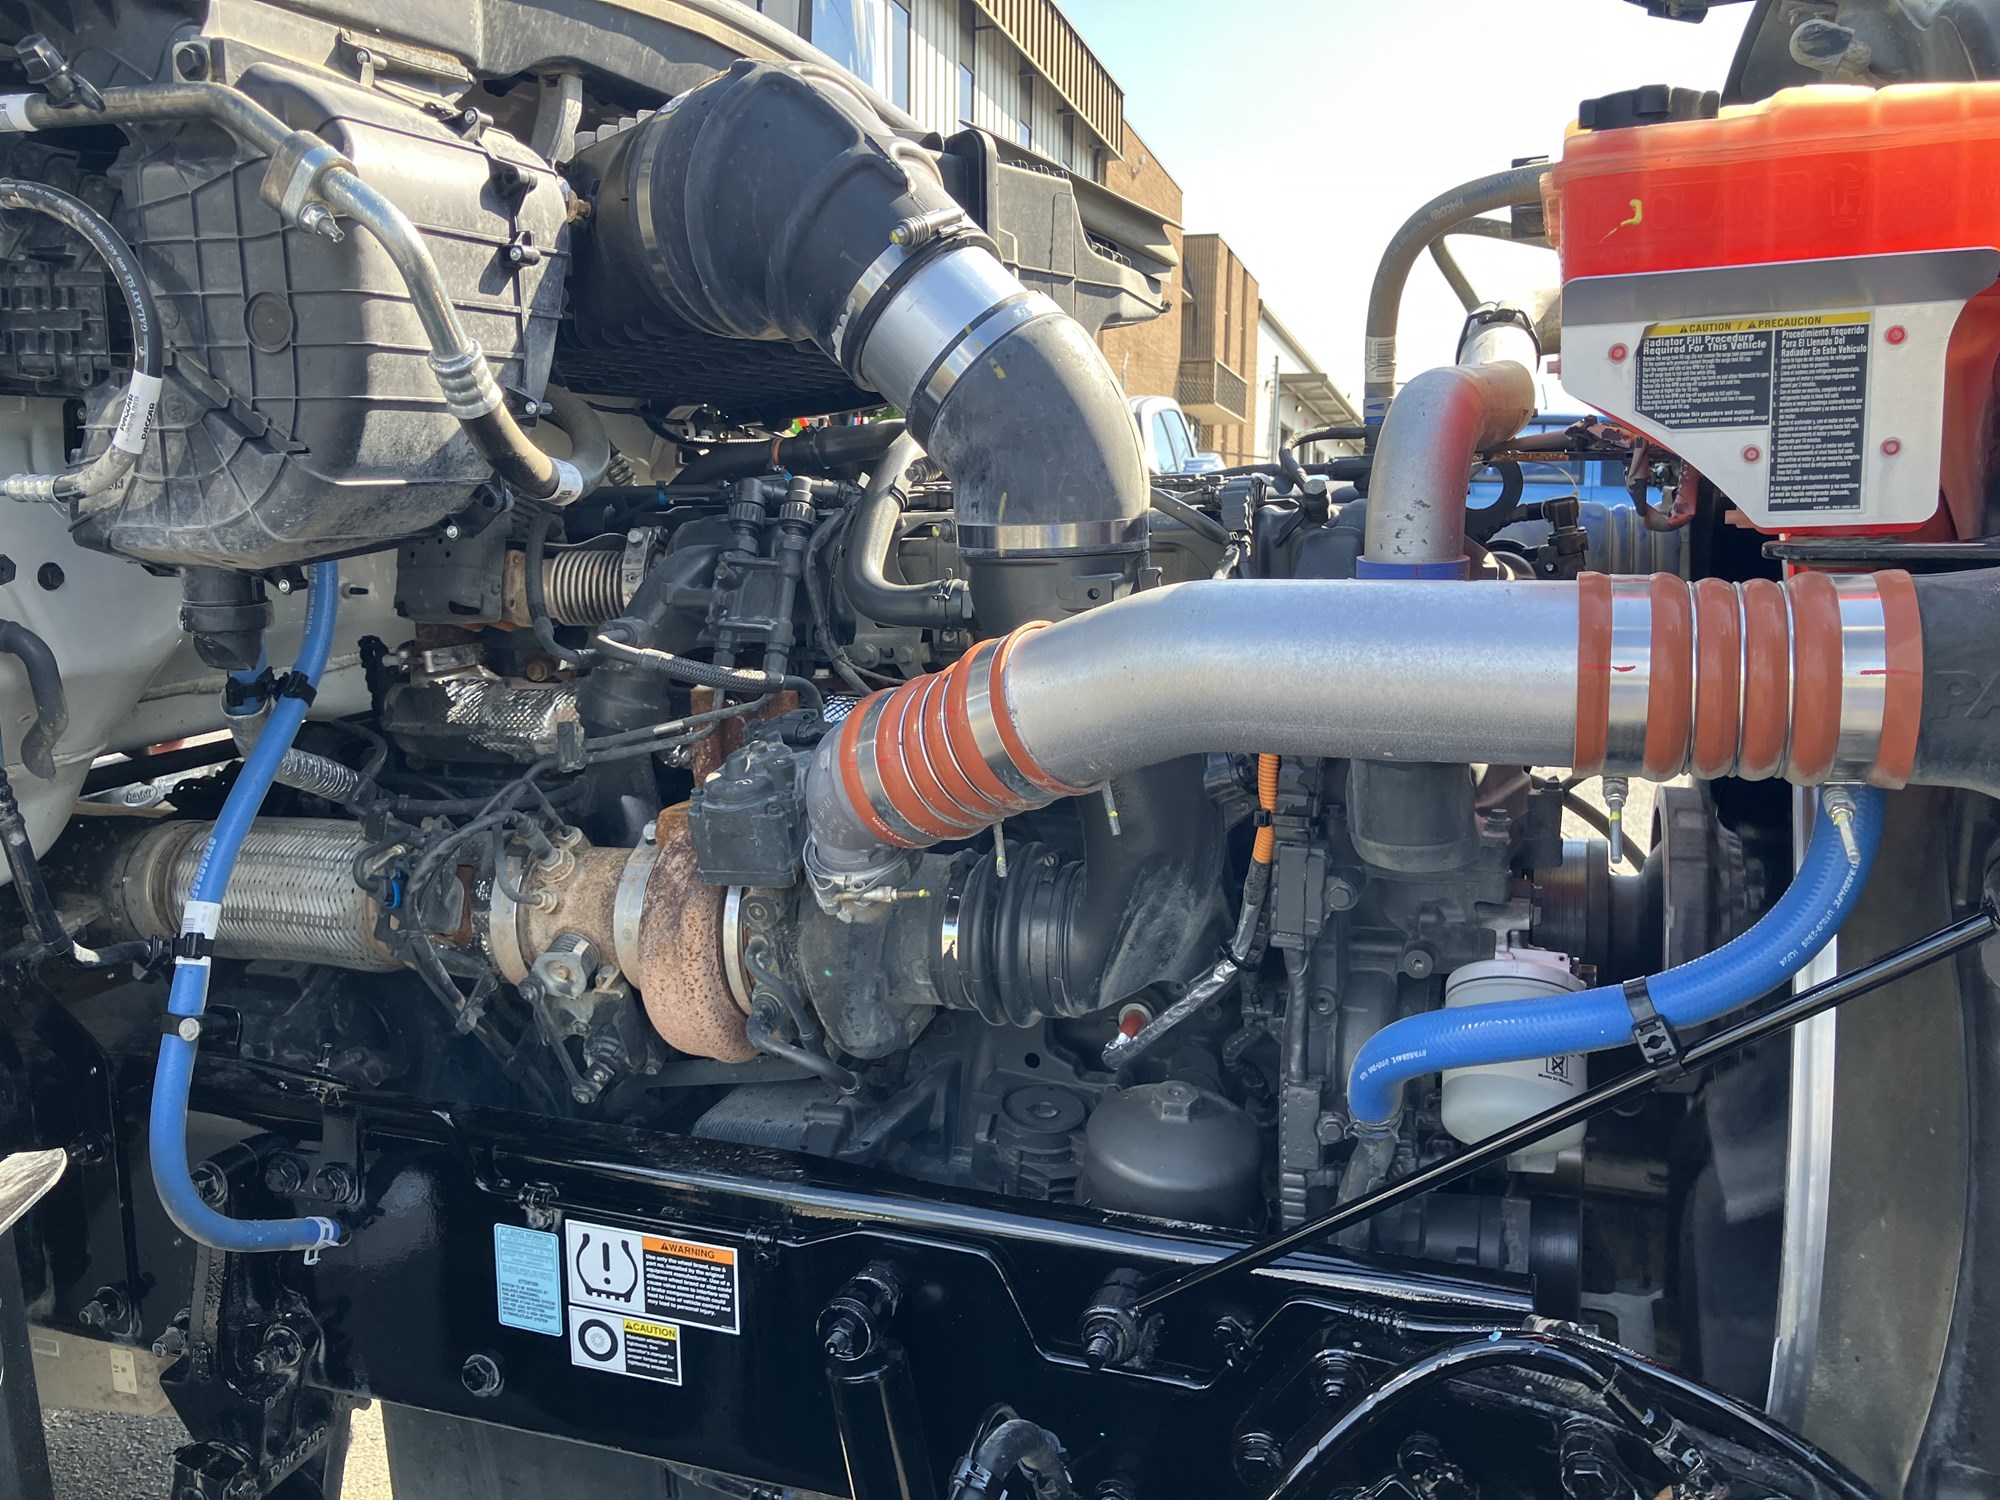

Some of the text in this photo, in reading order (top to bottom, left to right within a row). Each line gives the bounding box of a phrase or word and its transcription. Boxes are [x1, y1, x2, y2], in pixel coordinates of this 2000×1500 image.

[95, 228, 109, 244] HOSE
[124, 274, 136, 288] SLE
[131, 288, 148, 332] GALAXY
[1689, 323, 1731, 333] CAUTION
[1758, 316, 1822, 329] PRECAUCION
[1782, 326, 1864, 339] Procedimiento Requerido
[1643, 340, 1766, 356] Required For This Vehicle
[1644, 334, 1754, 348] Radiator Fill Procedure
[1782, 339, 1796, 348] Para
[1807, 338, 1832, 346] Llenado
[1834, 336, 1845, 344] Del
[1781, 348, 1810, 357] Radiador
[120, 394, 134, 431] PACCAR
[140, 402, 156, 440] PACCAR
[872, 816, 886, 831] MADE
[669, 1244, 714, 1258] WARNING
[657, 1255, 668, 1263] only
[678, 1259, 692, 1267] wheel
[693, 1262, 710, 1270] brand,
[666, 1264, 687, 1272] installed
[646, 1268, 672, 1276] equipment
[646, 1273, 667, 1281] different
[666, 1290, 694, 1299] component
[711, 1297, 726, 1305] could
[696, 1289, 718, 1297] interfere
[677, 1304, 699, 1312] personal
[700, 1307, 716, 1316] injury.
[702, 1302, 720, 1310] control
[633, 1323, 676, 1337] CAUTION
